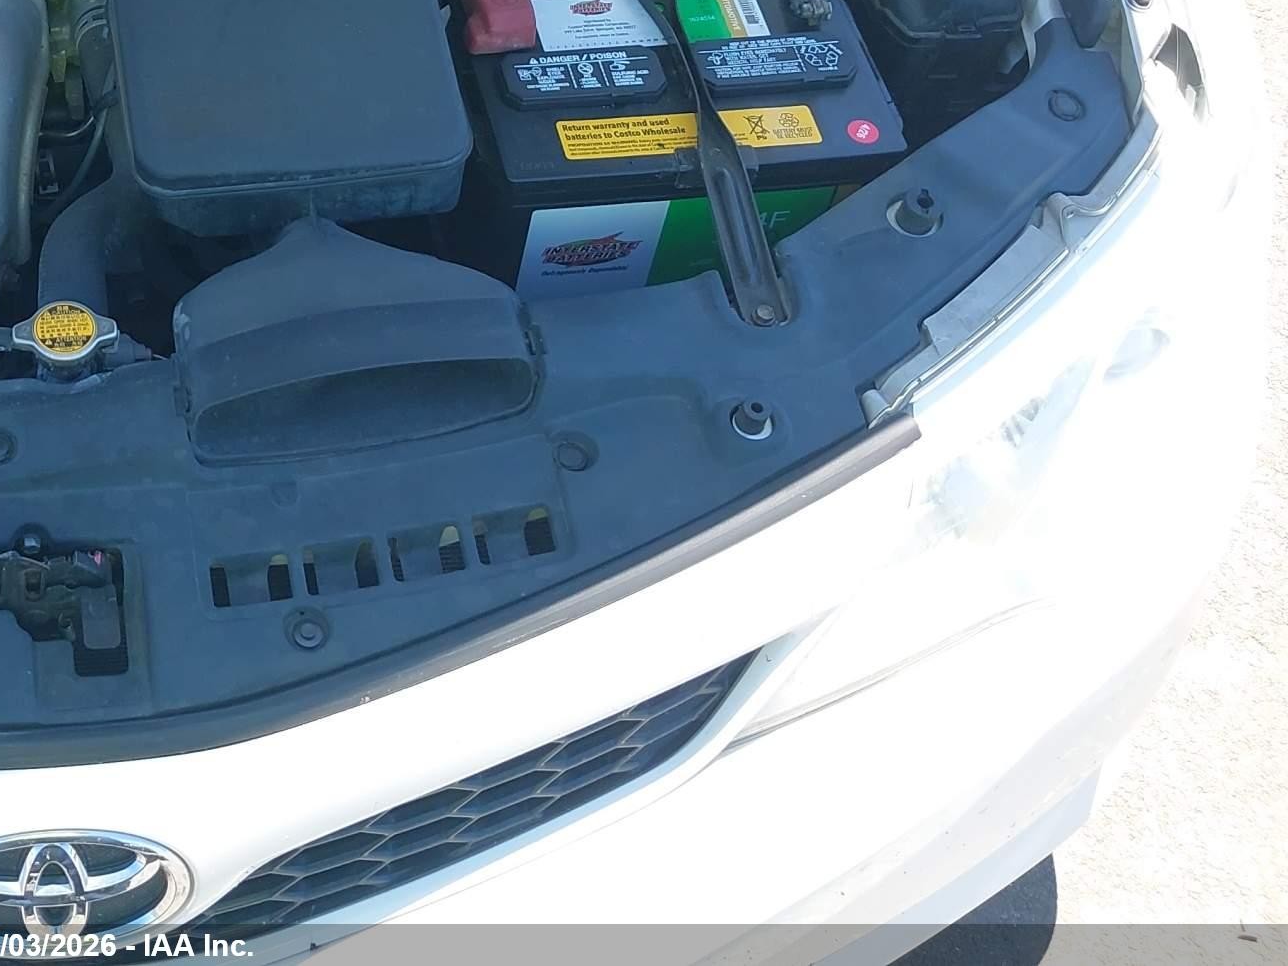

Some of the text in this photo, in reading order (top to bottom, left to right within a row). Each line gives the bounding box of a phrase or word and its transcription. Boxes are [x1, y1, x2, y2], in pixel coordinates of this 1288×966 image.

[539, 51, 627, 65] DANGER / POISON
[562, 117, 669, 132] Return warranty and used
[565, 126, 686, 141] batteries to Costco Wholesale
[760, 210, 791, 228] 4F
[542, 240, 641, 257] INTERSTATE
[542, 249, 630, 265] BATTERIES
